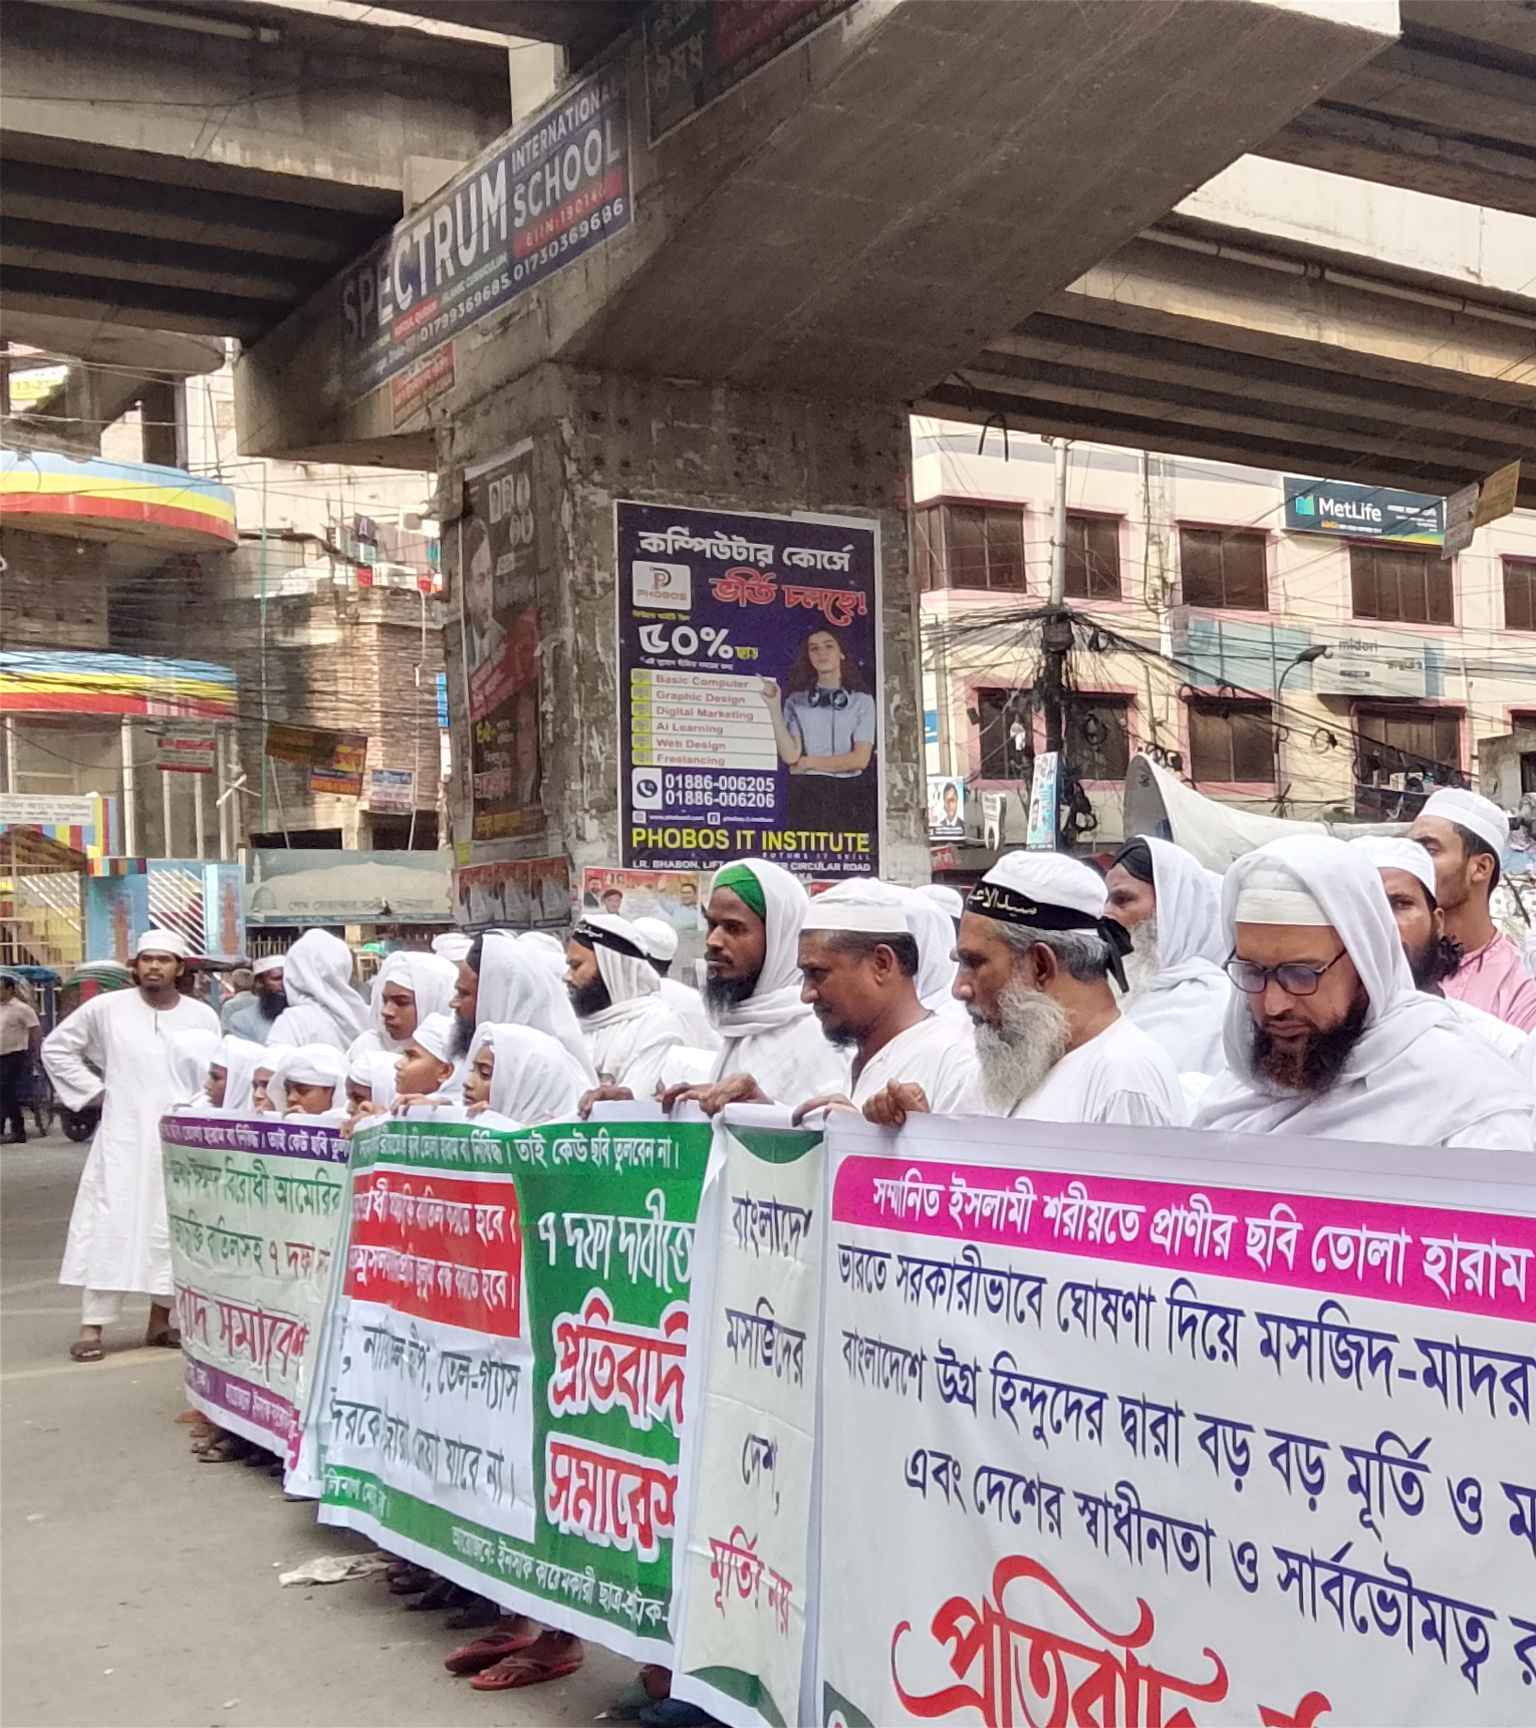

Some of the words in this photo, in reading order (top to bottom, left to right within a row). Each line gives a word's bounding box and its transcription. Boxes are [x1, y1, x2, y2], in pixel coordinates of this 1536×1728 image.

[513, 120, 621, 229] SCHOOL
[343, 161, 508, 338] SPECTRUM
[1318, 497, 1382, 522] MetLife
[639, 526, 774, 568] কম্পিউটার
[782, 544, 855, 572] কোর্সে
[708, 566, 778, 607] ভর্তি
[656, 673, 688, 684] Basic
[692, 677, 749, 689] Computer
[656, 690, 702, 702] Graphic
[705, 693, 745, 704] Design
[656, 706, 694, 719] Digital
[697, 709, 754, 721] Marketing
[672, 723, 724, 736] Learning
[656, 738, 681, 748] Web
[686, 739, 727, 751] Design
[656, 755, 726, 767] Freelancing
[665, 773, 775, 792] 01886-006205
[665, 790, 775, 808] 01886-006206
[632, 828, 729, 849] PHOBOS
[736, 830, 755, 850] IT
[762, 831, 870, 852] INSTITUTE
[844, 864, 872, 873] ROAD
[514, 1131, 548, 1169] তাই
[552, 1129, 590, 1165] কেউ
[591, 1127, 611, 1168] ছবি
[613, 1137, 657, 1176] তুলবেন
[657, 1137, 672, 1168] না
[474, 1203, 507, 1248] হবে
[537, 1212, 557, 1267] ৭
[562, 1212, 616, 1280] দফা
[873, 1167, 945, 1222] সম্মানিত
[949, 1172, 1037, 1235] ইসলামী
[1042, 1181, 1145, 1243] শরীয়তে
[1150, 1193, 1236, 1261] প্রাণীর
[1245, 1203, 1303, 1272] ছবি
[1311, 1223, 1412, 1286] তোলা
[1421, 1233, 1535, 1302] হারাম
[481, 1269, 508, 1312] হবে
[837, 1243, 893, 1294] ভারতে
[896, 1243, 1048, 1338] সরকারীভাবে
[1056, 1278, 1157, 1356] ঘোষণা
[1166, 1277, 1247, 1369] দিয়ে
[842, 1327, 929, 1402] বাংলাদেশে
[934, 1338, 981, 1419] উগ্র
[989, 1349, 1109, 1451] হিন্দুদের
[1118, 1391, 1185, 1468] দ্বারা
[1195, 1411, 1255, 1494] বড়
[1264, 1428, 1330, 1512] বড়
[1341, 1430, 1433, 1543] মূর্তি
[1447, 1474, 1484, 1537] ও
[904, 1448, 970, 1515] এবং
[973, 1464, 1065, 1538] দেশের
[1074, 1480, 1217, 1586] স্বাধীনতা
[1229, 1539, 1260, 1595] ও
[1272, 1541, 1498, 1694] সার্বভৌমত্ব
